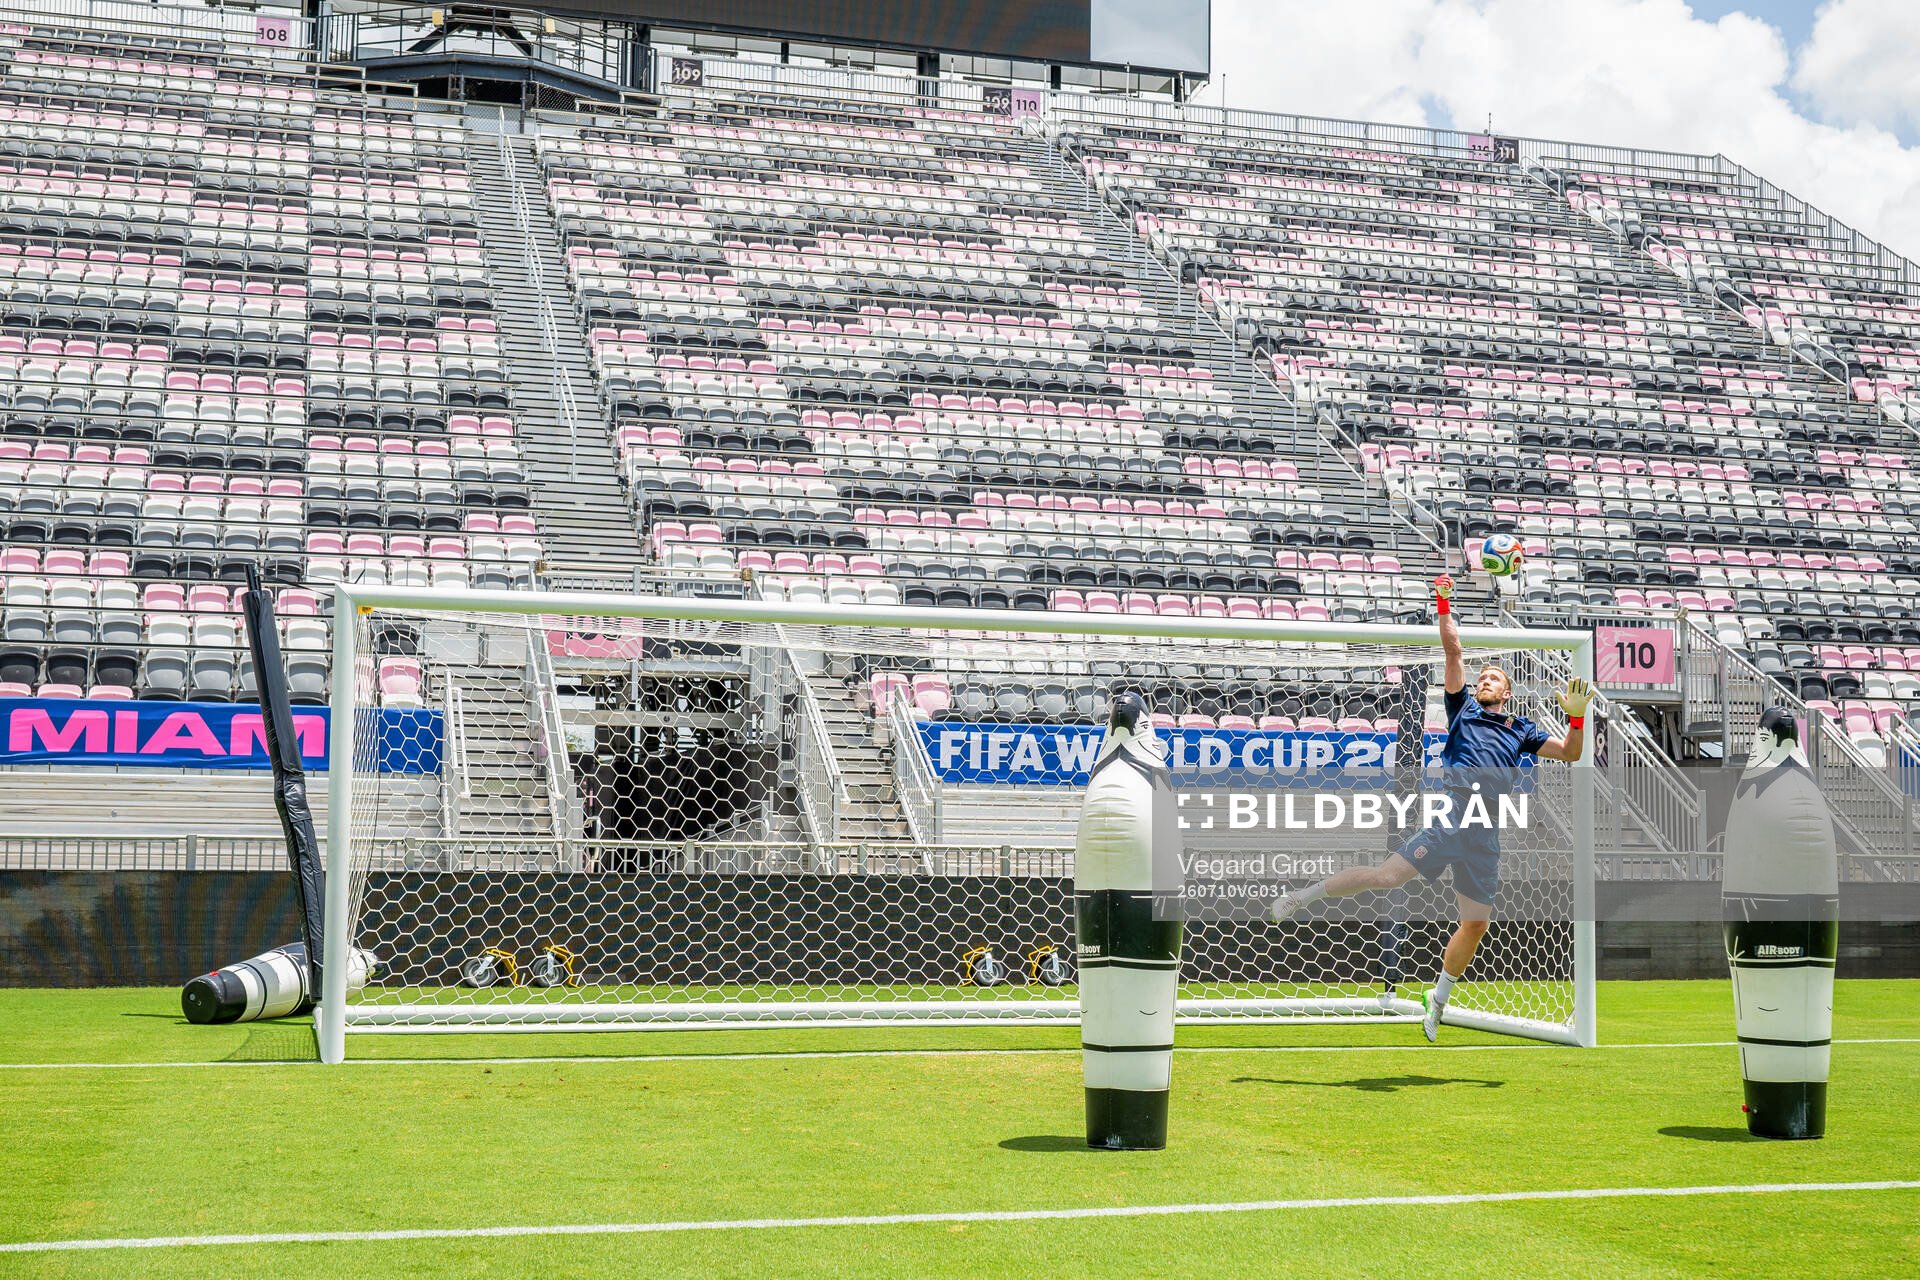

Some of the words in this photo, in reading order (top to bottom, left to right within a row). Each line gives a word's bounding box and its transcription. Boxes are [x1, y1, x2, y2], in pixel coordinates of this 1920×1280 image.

[259, 27, 287, 41] 108
[674, 67, 701, 80] 109
[1016, 99, 1037, 111] 110
[1615, 642, 1655, 669] 110
[9, 708, 325, 757] MIAM
[940, 731, 1046, 771] FIFA
[1054, 734, 1232, 774] WLD
[1242, 738, 1335, 776] CUP
